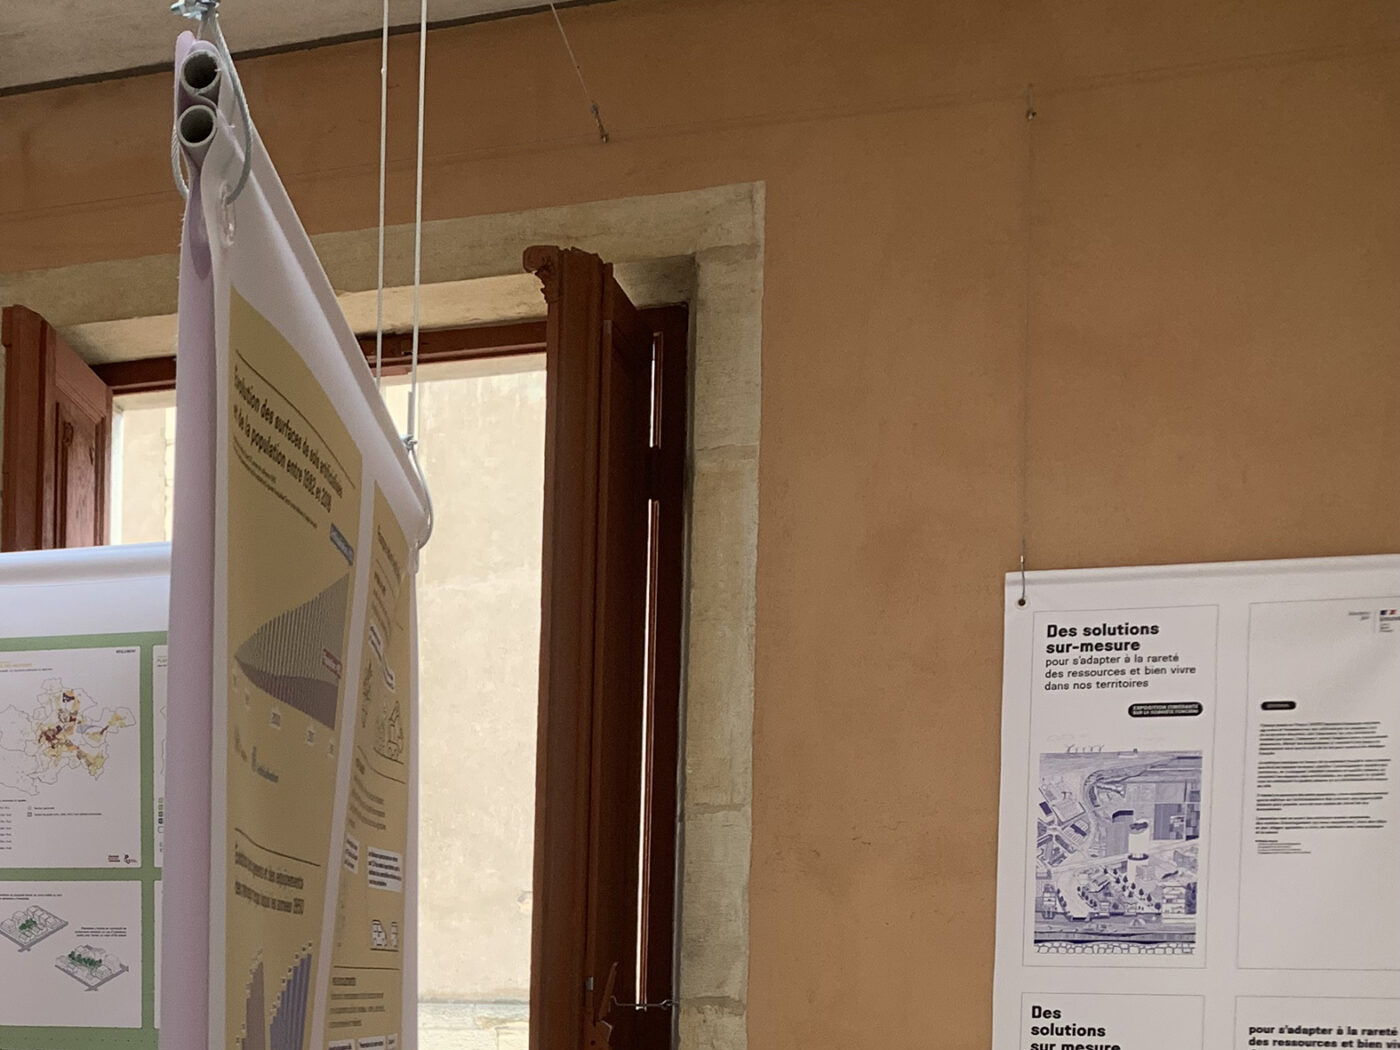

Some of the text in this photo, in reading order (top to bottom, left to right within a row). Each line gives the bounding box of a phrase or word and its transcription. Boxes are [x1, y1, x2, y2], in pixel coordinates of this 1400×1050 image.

[1047, 622, 1158, 638] Des solutions
[1046, 641, 1139, 654] sur-mesure
[1045, 653, 1179, 668] pour s'adapter à la rareté
[1044, 664, 1196, 678] des ressources et bien vivre
[1044, 680, 1069, 690] dans
[1095, 680, 1148, 688] territoires
[1031, 1005, 1061, 1019] Des
[1031, 1022, 1105, 1037] solutions
[1248, 1024, 1398, 1036] pour s'adapter à la rareté
[1248, 1036, 1269, 1046] des
[1272, 1039, 1337, 1047] ressources
[1340, 1040, 1354, 1048] et
[1356, 1038, 1382, 1048] bien
